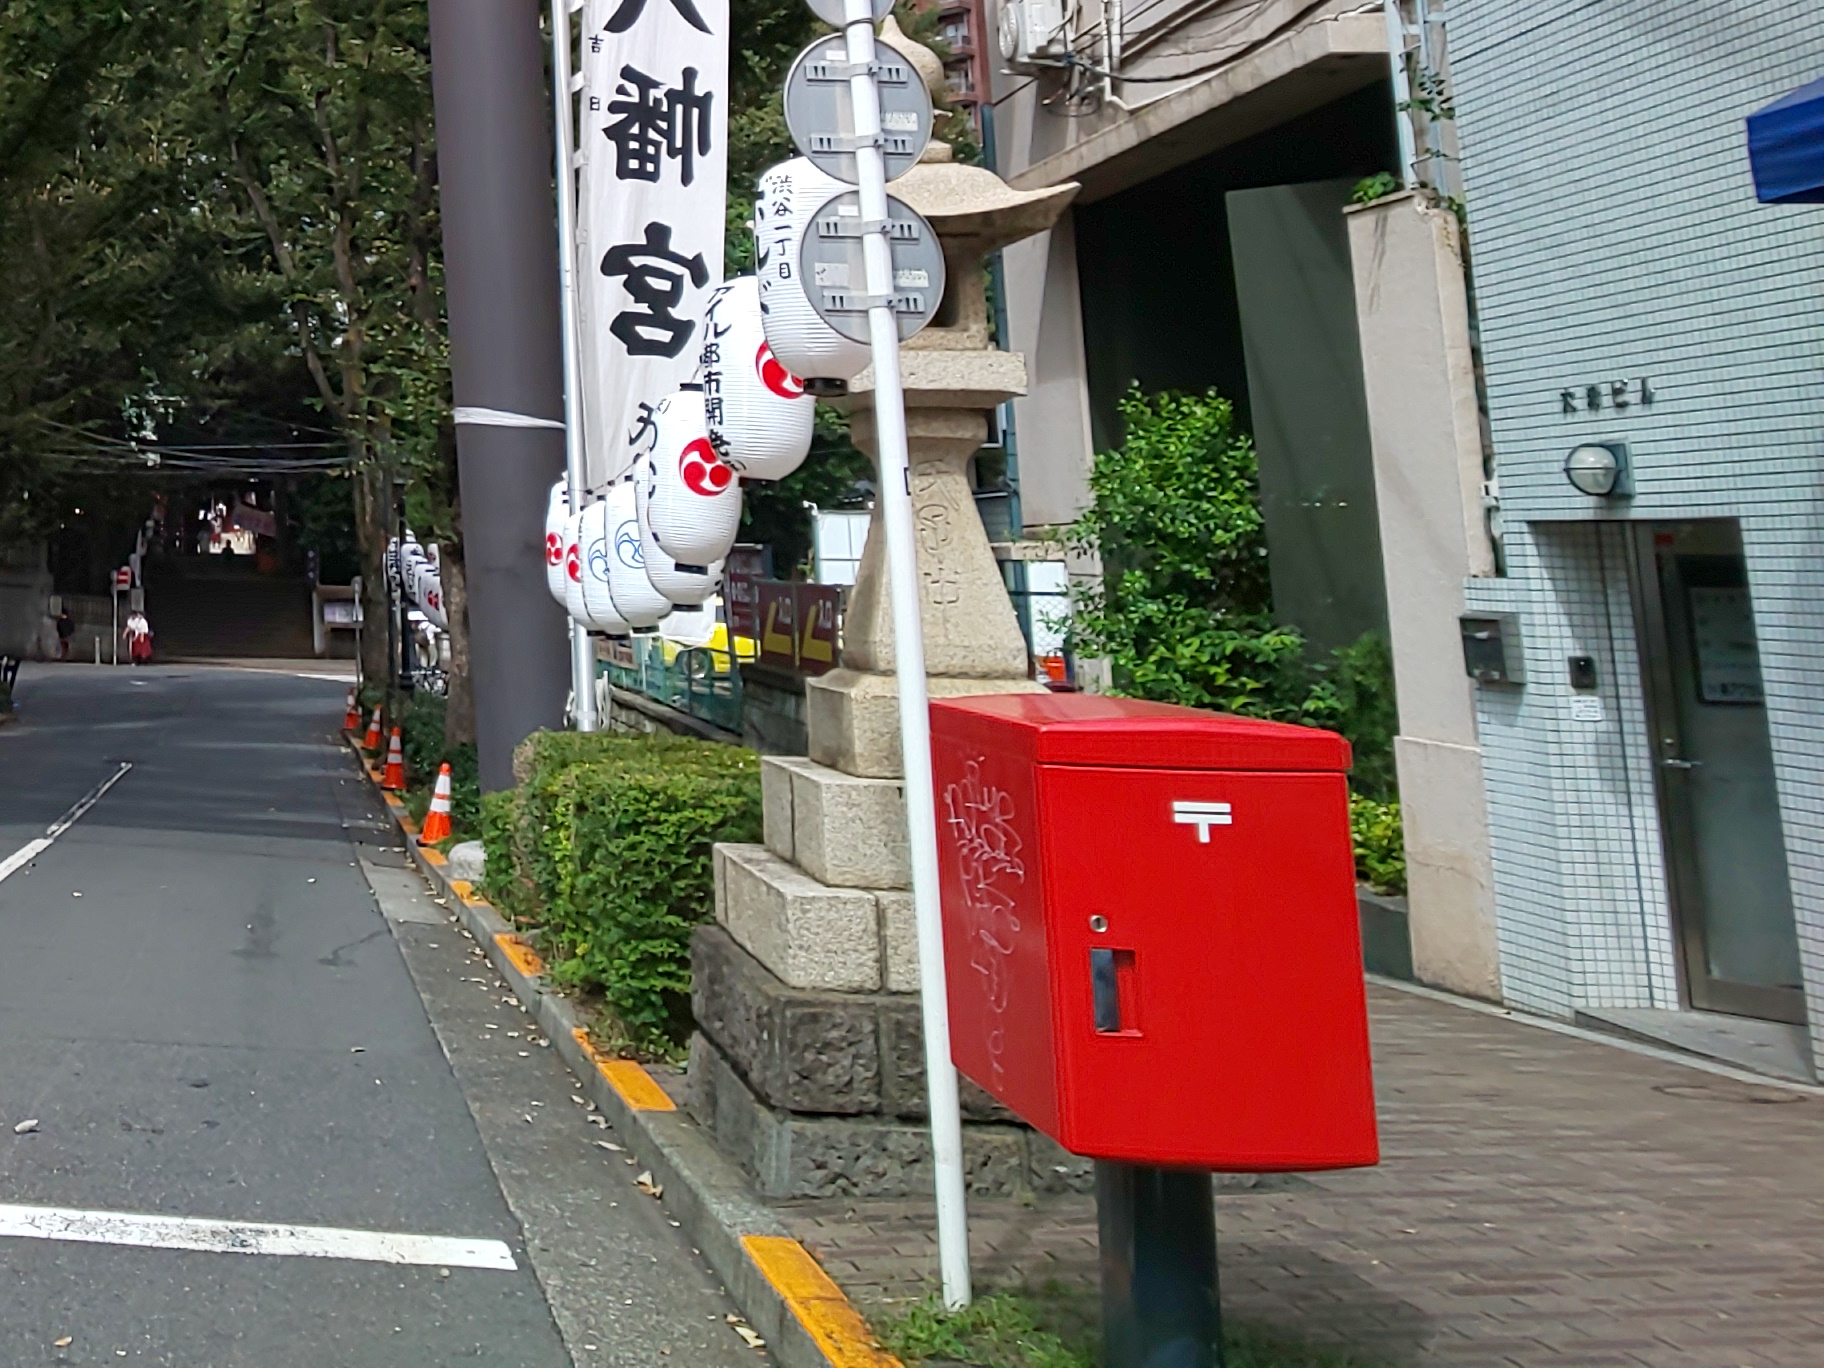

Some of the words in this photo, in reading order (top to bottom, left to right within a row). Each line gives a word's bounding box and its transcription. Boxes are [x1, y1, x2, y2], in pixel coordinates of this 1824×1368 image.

[771, 174, 794, 280] 渋谷一丁目
